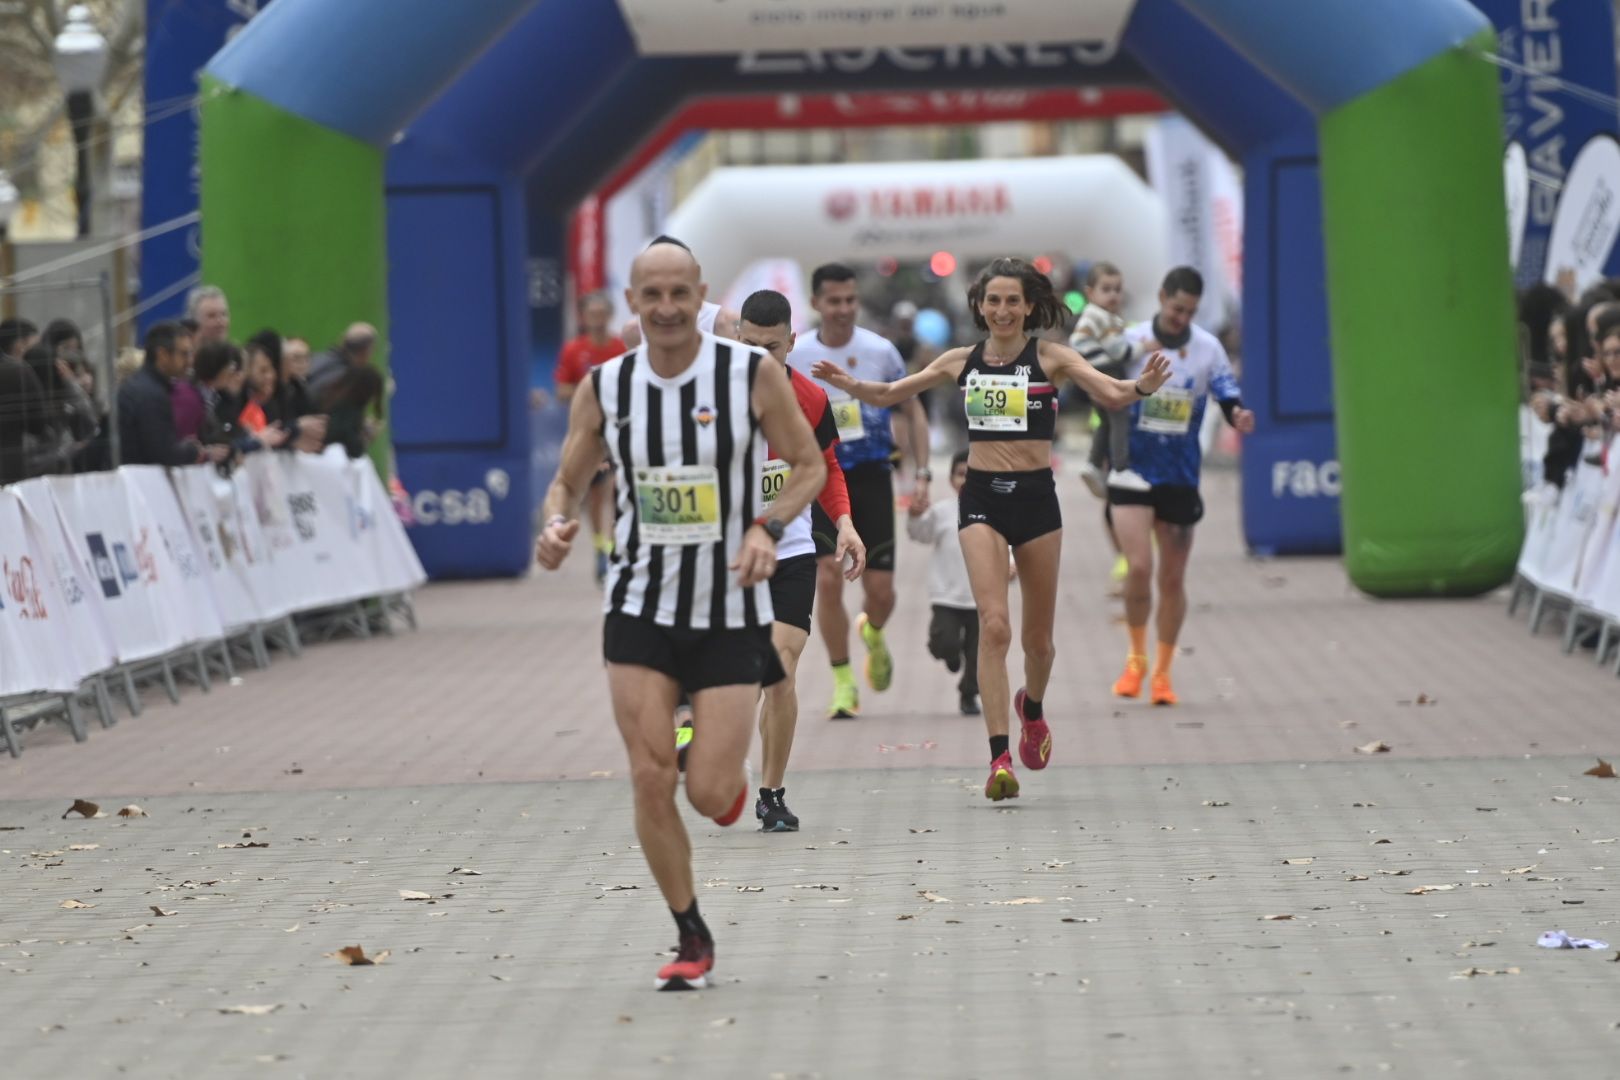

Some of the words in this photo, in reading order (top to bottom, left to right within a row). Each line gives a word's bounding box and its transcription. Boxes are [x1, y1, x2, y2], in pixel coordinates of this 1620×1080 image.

[984, 390, 1007, 408] 59
[762, 474, 784, 494] 00
[1272, 460, 1343, 497] fac
[414, 488, 494, 525] csa
[652, 487, 697, 514] 301
